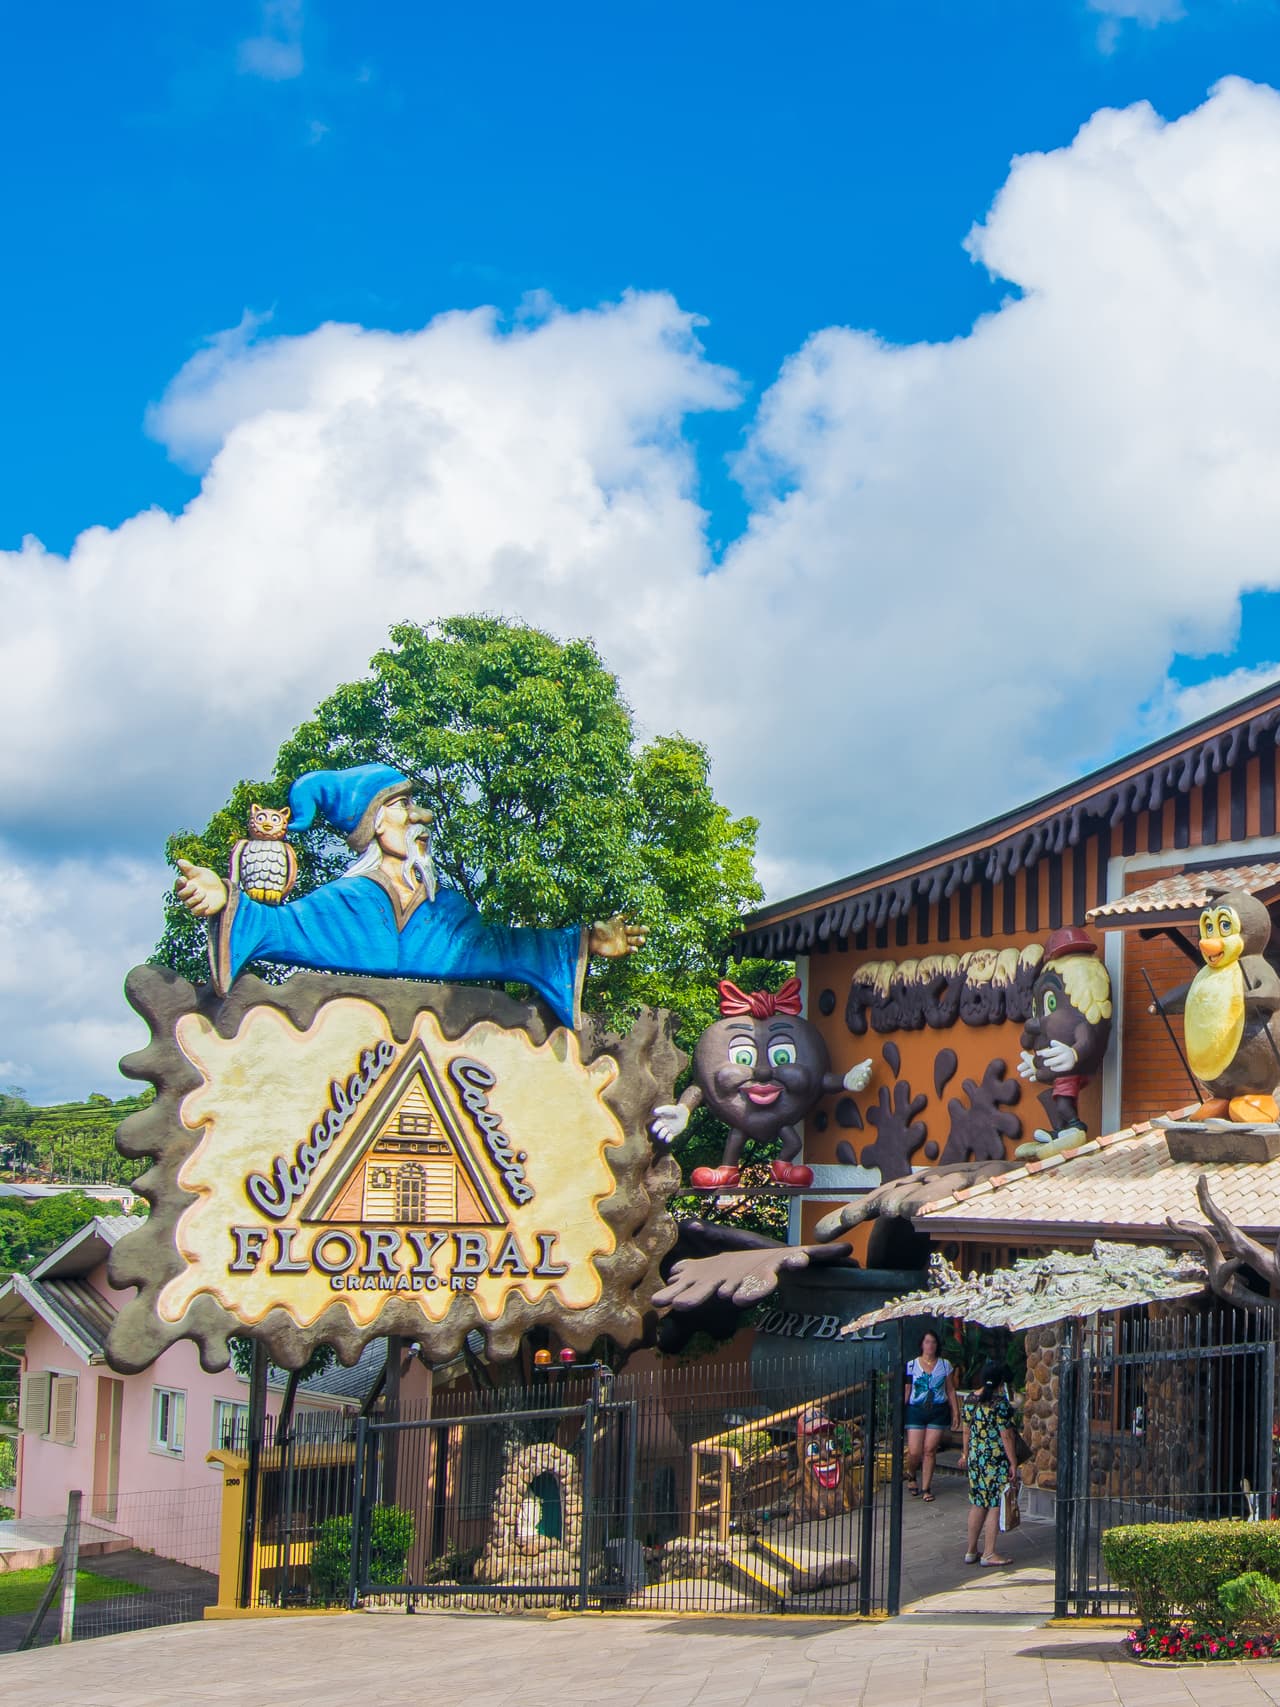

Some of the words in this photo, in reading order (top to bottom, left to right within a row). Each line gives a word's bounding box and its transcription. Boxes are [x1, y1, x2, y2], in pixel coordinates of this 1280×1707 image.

[246, 1039, 396, 1220] Chocolate
[450, 1055, 535, 1208] Caseiro
[229, 1226, 569, 1278] FLORYBAL
